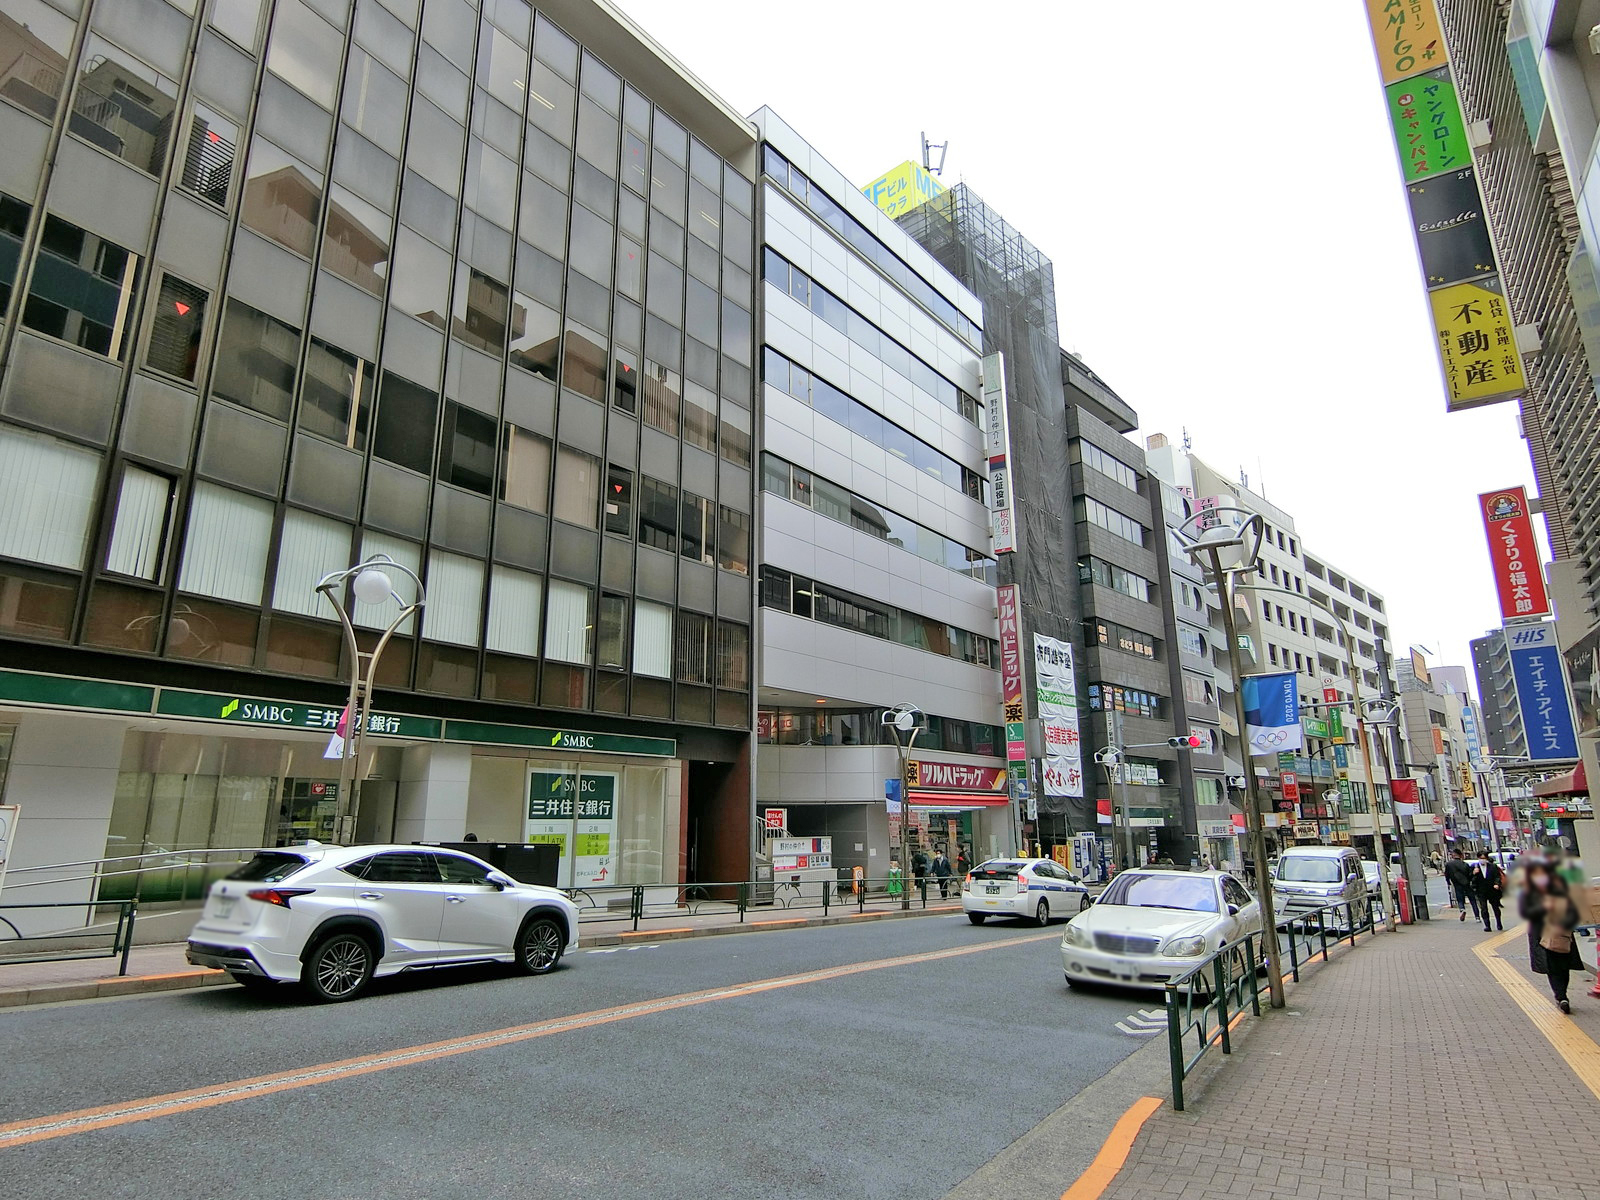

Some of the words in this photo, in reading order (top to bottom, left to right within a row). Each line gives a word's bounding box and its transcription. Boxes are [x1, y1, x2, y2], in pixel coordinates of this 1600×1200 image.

[1434, 70, 1447, 79] 3F
[1424, 84, 1455, 167] ヤングローン
[1401, 107, 1429, 174] キャンパス
[1457, 170, 1472, 180] 2F
[1418, 211, 1477, 232] Estrella
[1483, 279, 1497, 288] 1F
[1450, 299, 1498, 386] 不動産
[1500, 520, 1533, 613] くすりの福太郎
[999, 588, 1021, 692] ツルハドラッグ
[1512, 629, 1546, 644] HIS
[1283, 679, 1292, 704] TOKYO
[242, 703, 293, 723] SMBC
[1005, 704, 1023, 722] 薬
[1285, 704, 1294, 723] 2020
[1529, 655, 1560, 751] エイチ・アイ・エス
[305, 709, 401, 733] 三井友銀行
[563, 734, 594, 748] SMBC
[921, 763, 985, 787] ツルハドラッグ
[531, 799, 611, 816] 三井住友銀行
